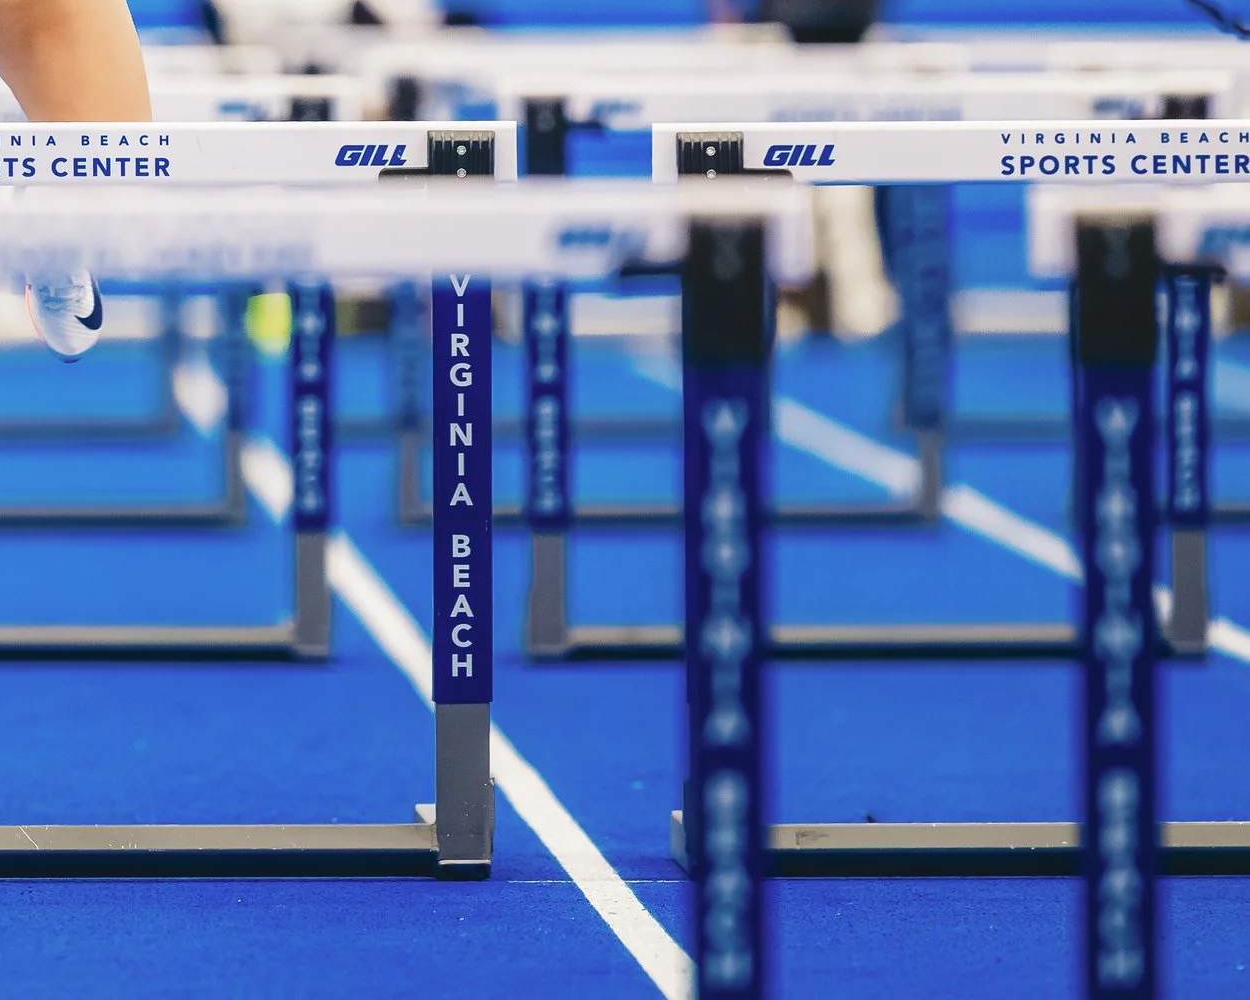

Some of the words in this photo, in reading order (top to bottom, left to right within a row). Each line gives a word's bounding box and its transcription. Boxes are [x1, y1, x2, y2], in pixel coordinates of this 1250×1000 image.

[81, 134, 170, 147] BEACH
[1000, 132, 1138, 145] VIRGINIA
[1160, 131, 1250, 145] BEACH
[334, 144, 407, 167] GILL
[762, 144, 836, 167] GILL
[1001, 154, 1117, 176] SPORTS
[1130, 154, 1250, 176] CENTER
[50, 157, 170, 178] CENTER
[448, 274, 474, 506] VIRGINIA
[449, 534, 474, 678] BEACH
